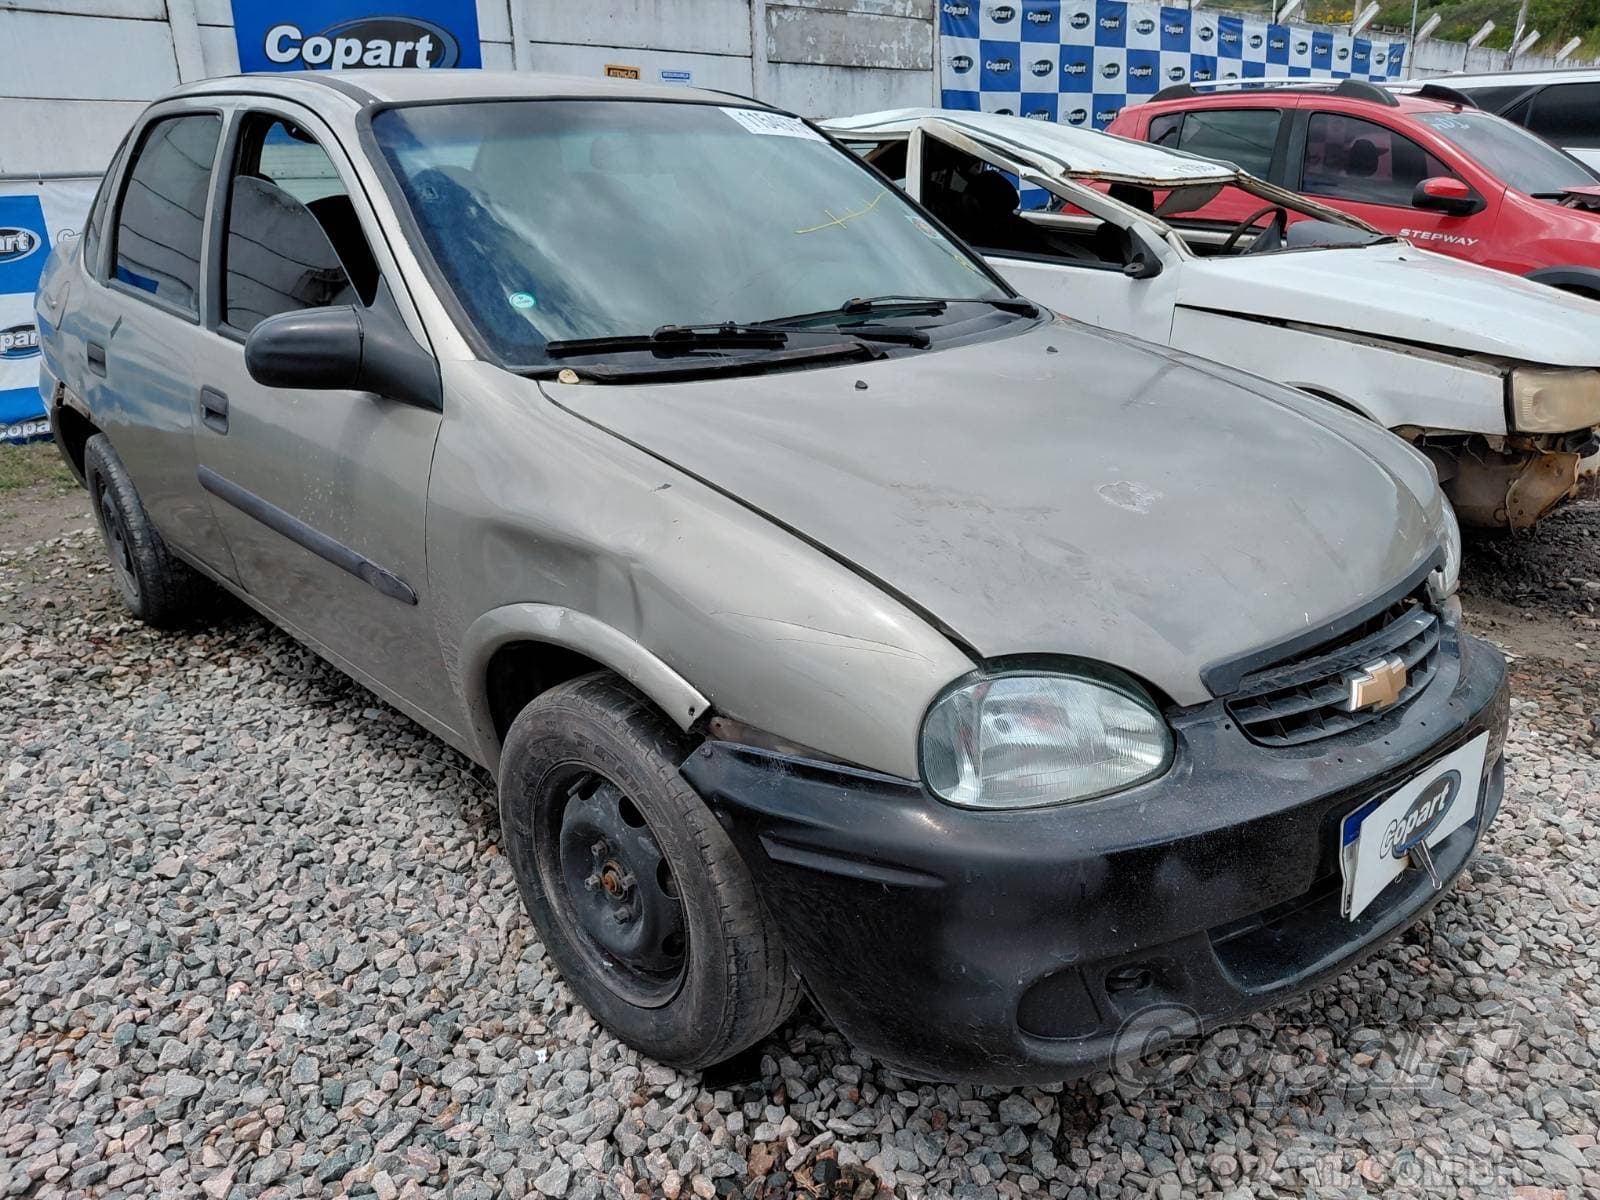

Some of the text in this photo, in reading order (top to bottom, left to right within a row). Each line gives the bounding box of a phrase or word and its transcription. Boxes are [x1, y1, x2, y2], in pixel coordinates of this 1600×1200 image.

[943, 4, 969, 16] Copart
[1027, 12, 1051, 23] Copart
[1100, 17, 1119, 29] Copart
[1165, 25, 1184, 34] Copart
[265, 25, 433, 70] Copart
[985, 60, 1011, 72] Copart
[1064, 64, 1086, 74] Copart
[1129, 67, 1152, 77] Copart
[1096, 112, 1117, 122] Copart
[1399, 228, 1479, 246] STEPWAY
[1379, 781, 1450, 859] Copart
